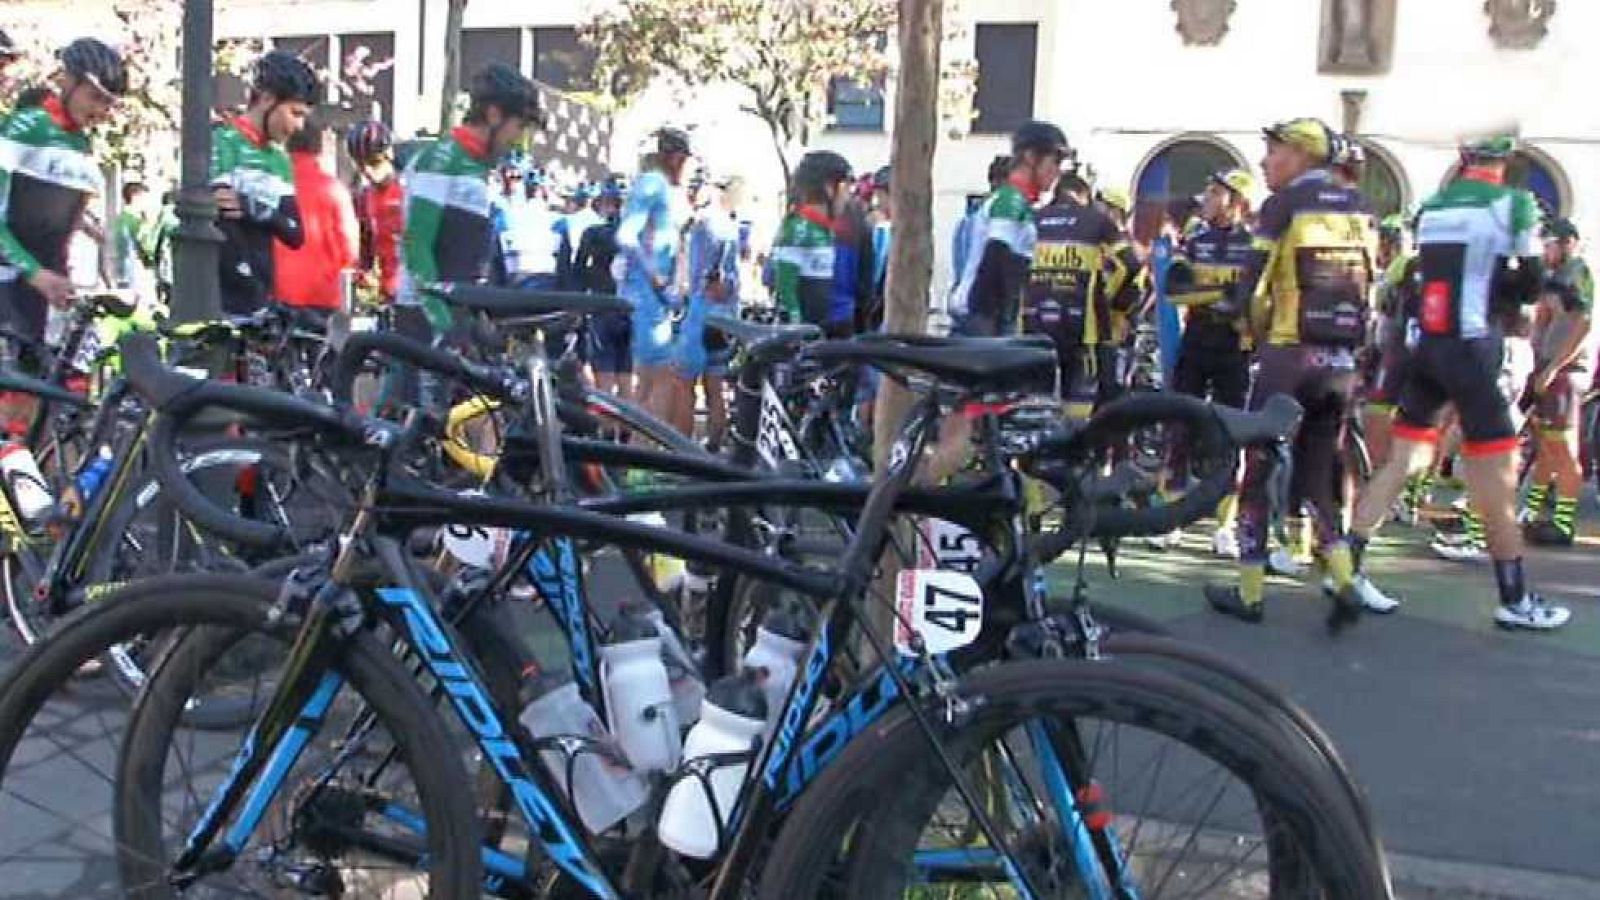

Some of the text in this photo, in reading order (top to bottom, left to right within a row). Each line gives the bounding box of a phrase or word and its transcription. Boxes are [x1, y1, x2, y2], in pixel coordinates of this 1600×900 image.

[938, 533, 982, 573] 45
[925, 584, 981, 633] 47
[375, 587, 618, 900] RIDLEY
